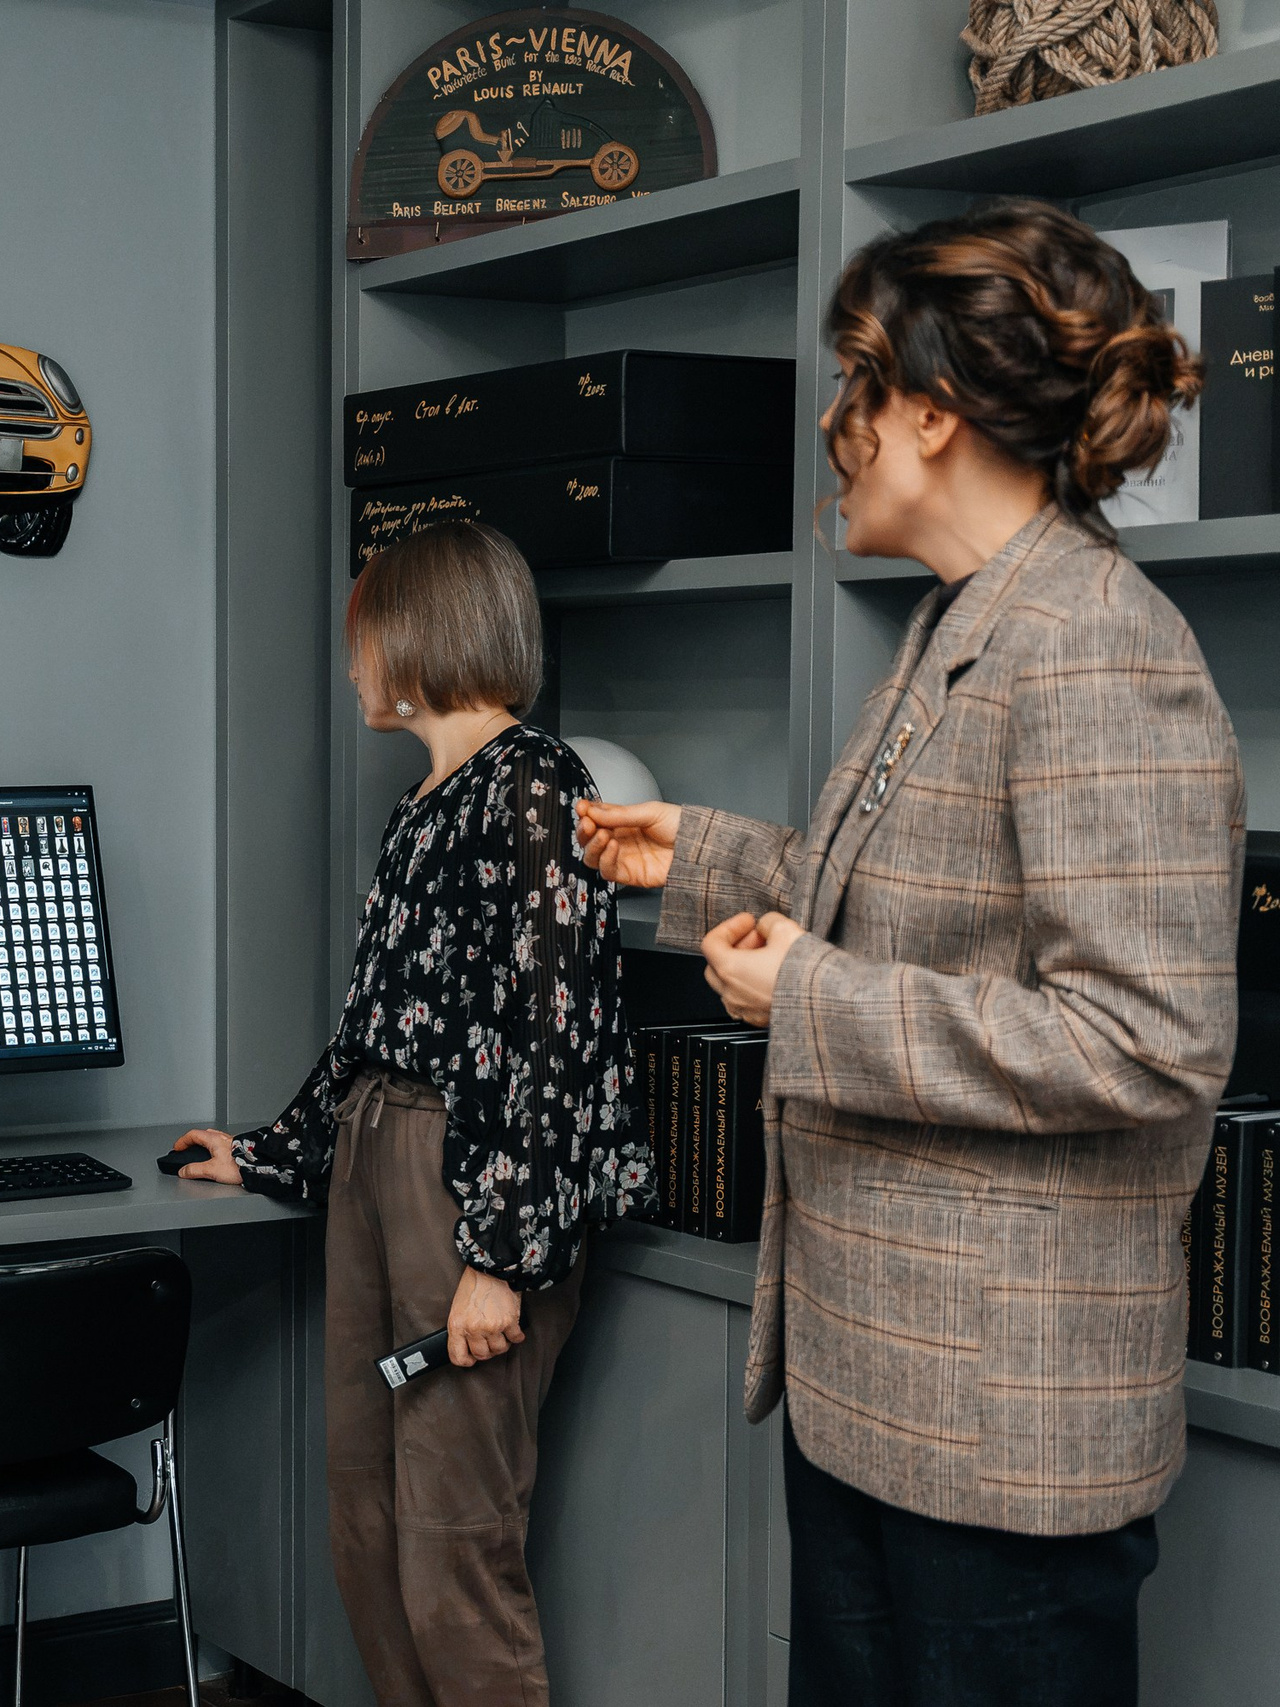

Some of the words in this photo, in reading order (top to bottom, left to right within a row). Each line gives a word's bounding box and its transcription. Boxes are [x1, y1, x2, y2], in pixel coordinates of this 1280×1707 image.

[473, 85, 514, 102] LOUIS
[522, 82, 584, 97] RENAULT
[529, 70, 544, 83] BY
[392, 202, 421, 218] PARIS
[433, 201, 482, 216] BELFORT
[1244, 367, 1255, 378] и
[647, 1053, 656, 1095] МУЗЕЙ
[671, 1055, 680, 1098] МУЗЕЙ
[693, 1059, 702, 1102] МУЗЕЙ
[717, 1062, 727, 1105] МУЗЕЙ
[669, 1101, 679, 1208] ВООБРАЖАЕМЫЙ
[692, 1105, 701, 1214] ВООБРАЖАЕМЫЙ
[715, 1109, 726, 1218] ВООБРАЖАЕМЫЙ
[1214, 1145, 1228, 1198] МУЗЕЙ
[1262, 1149, 1274, 1202] МУЗЕЙ
[1212, 1203, 1226, 1338] ВООБРАЖАЕМЫЙ
[1260, 1206, 1272, 1344] ВООБРАЖАЕМЫЙ
